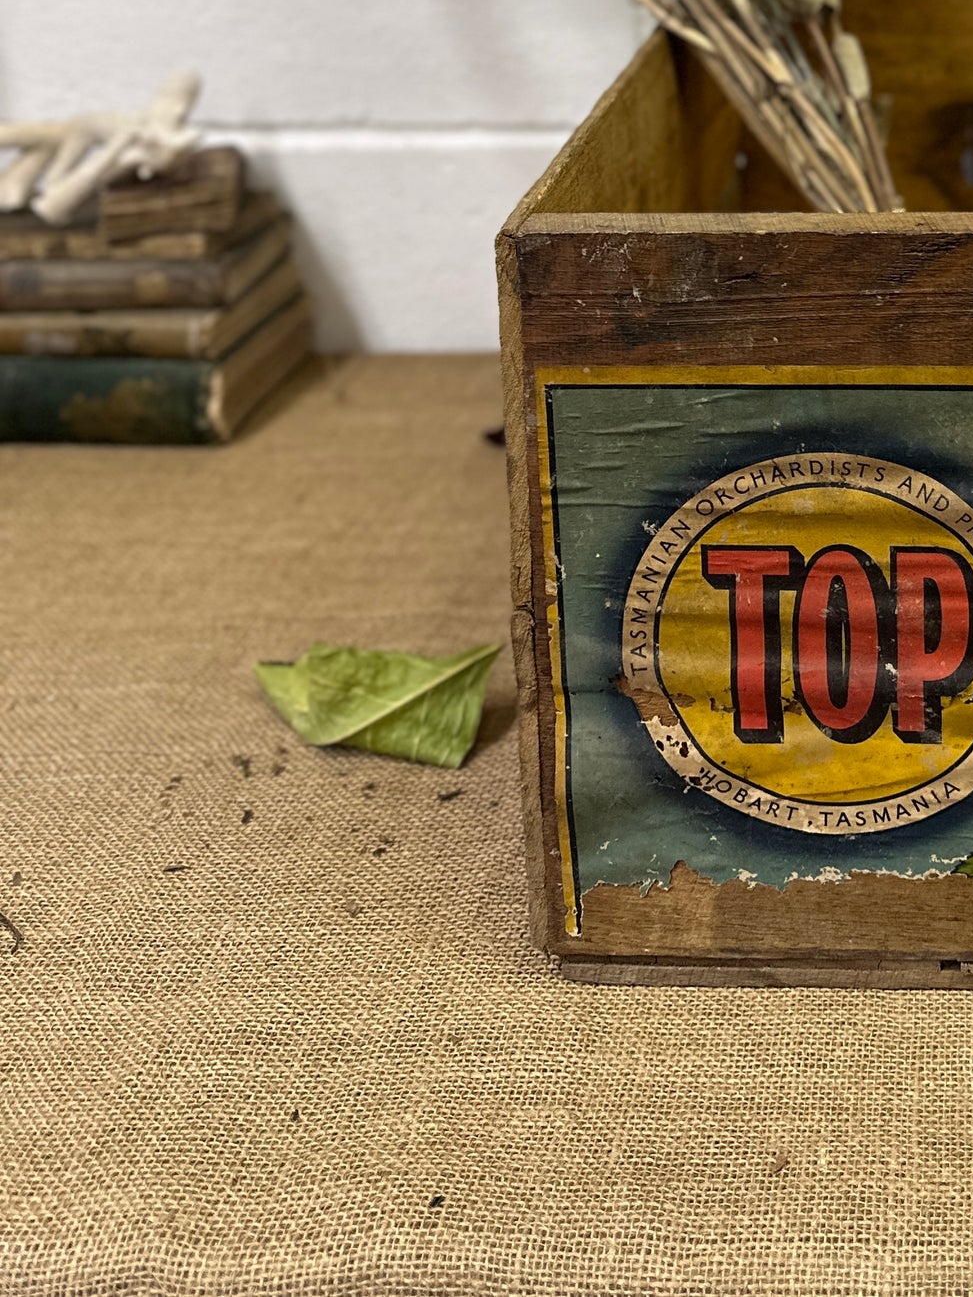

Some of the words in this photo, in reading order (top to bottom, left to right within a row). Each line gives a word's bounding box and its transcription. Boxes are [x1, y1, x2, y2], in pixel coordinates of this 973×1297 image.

[630, 520, 692, 677] TASMANIAN
[695, 460, 888, 518] ORCHARDISTS
[899, 480, 951, 512] AND
[819, 781, 961, 828] TASMANIA
